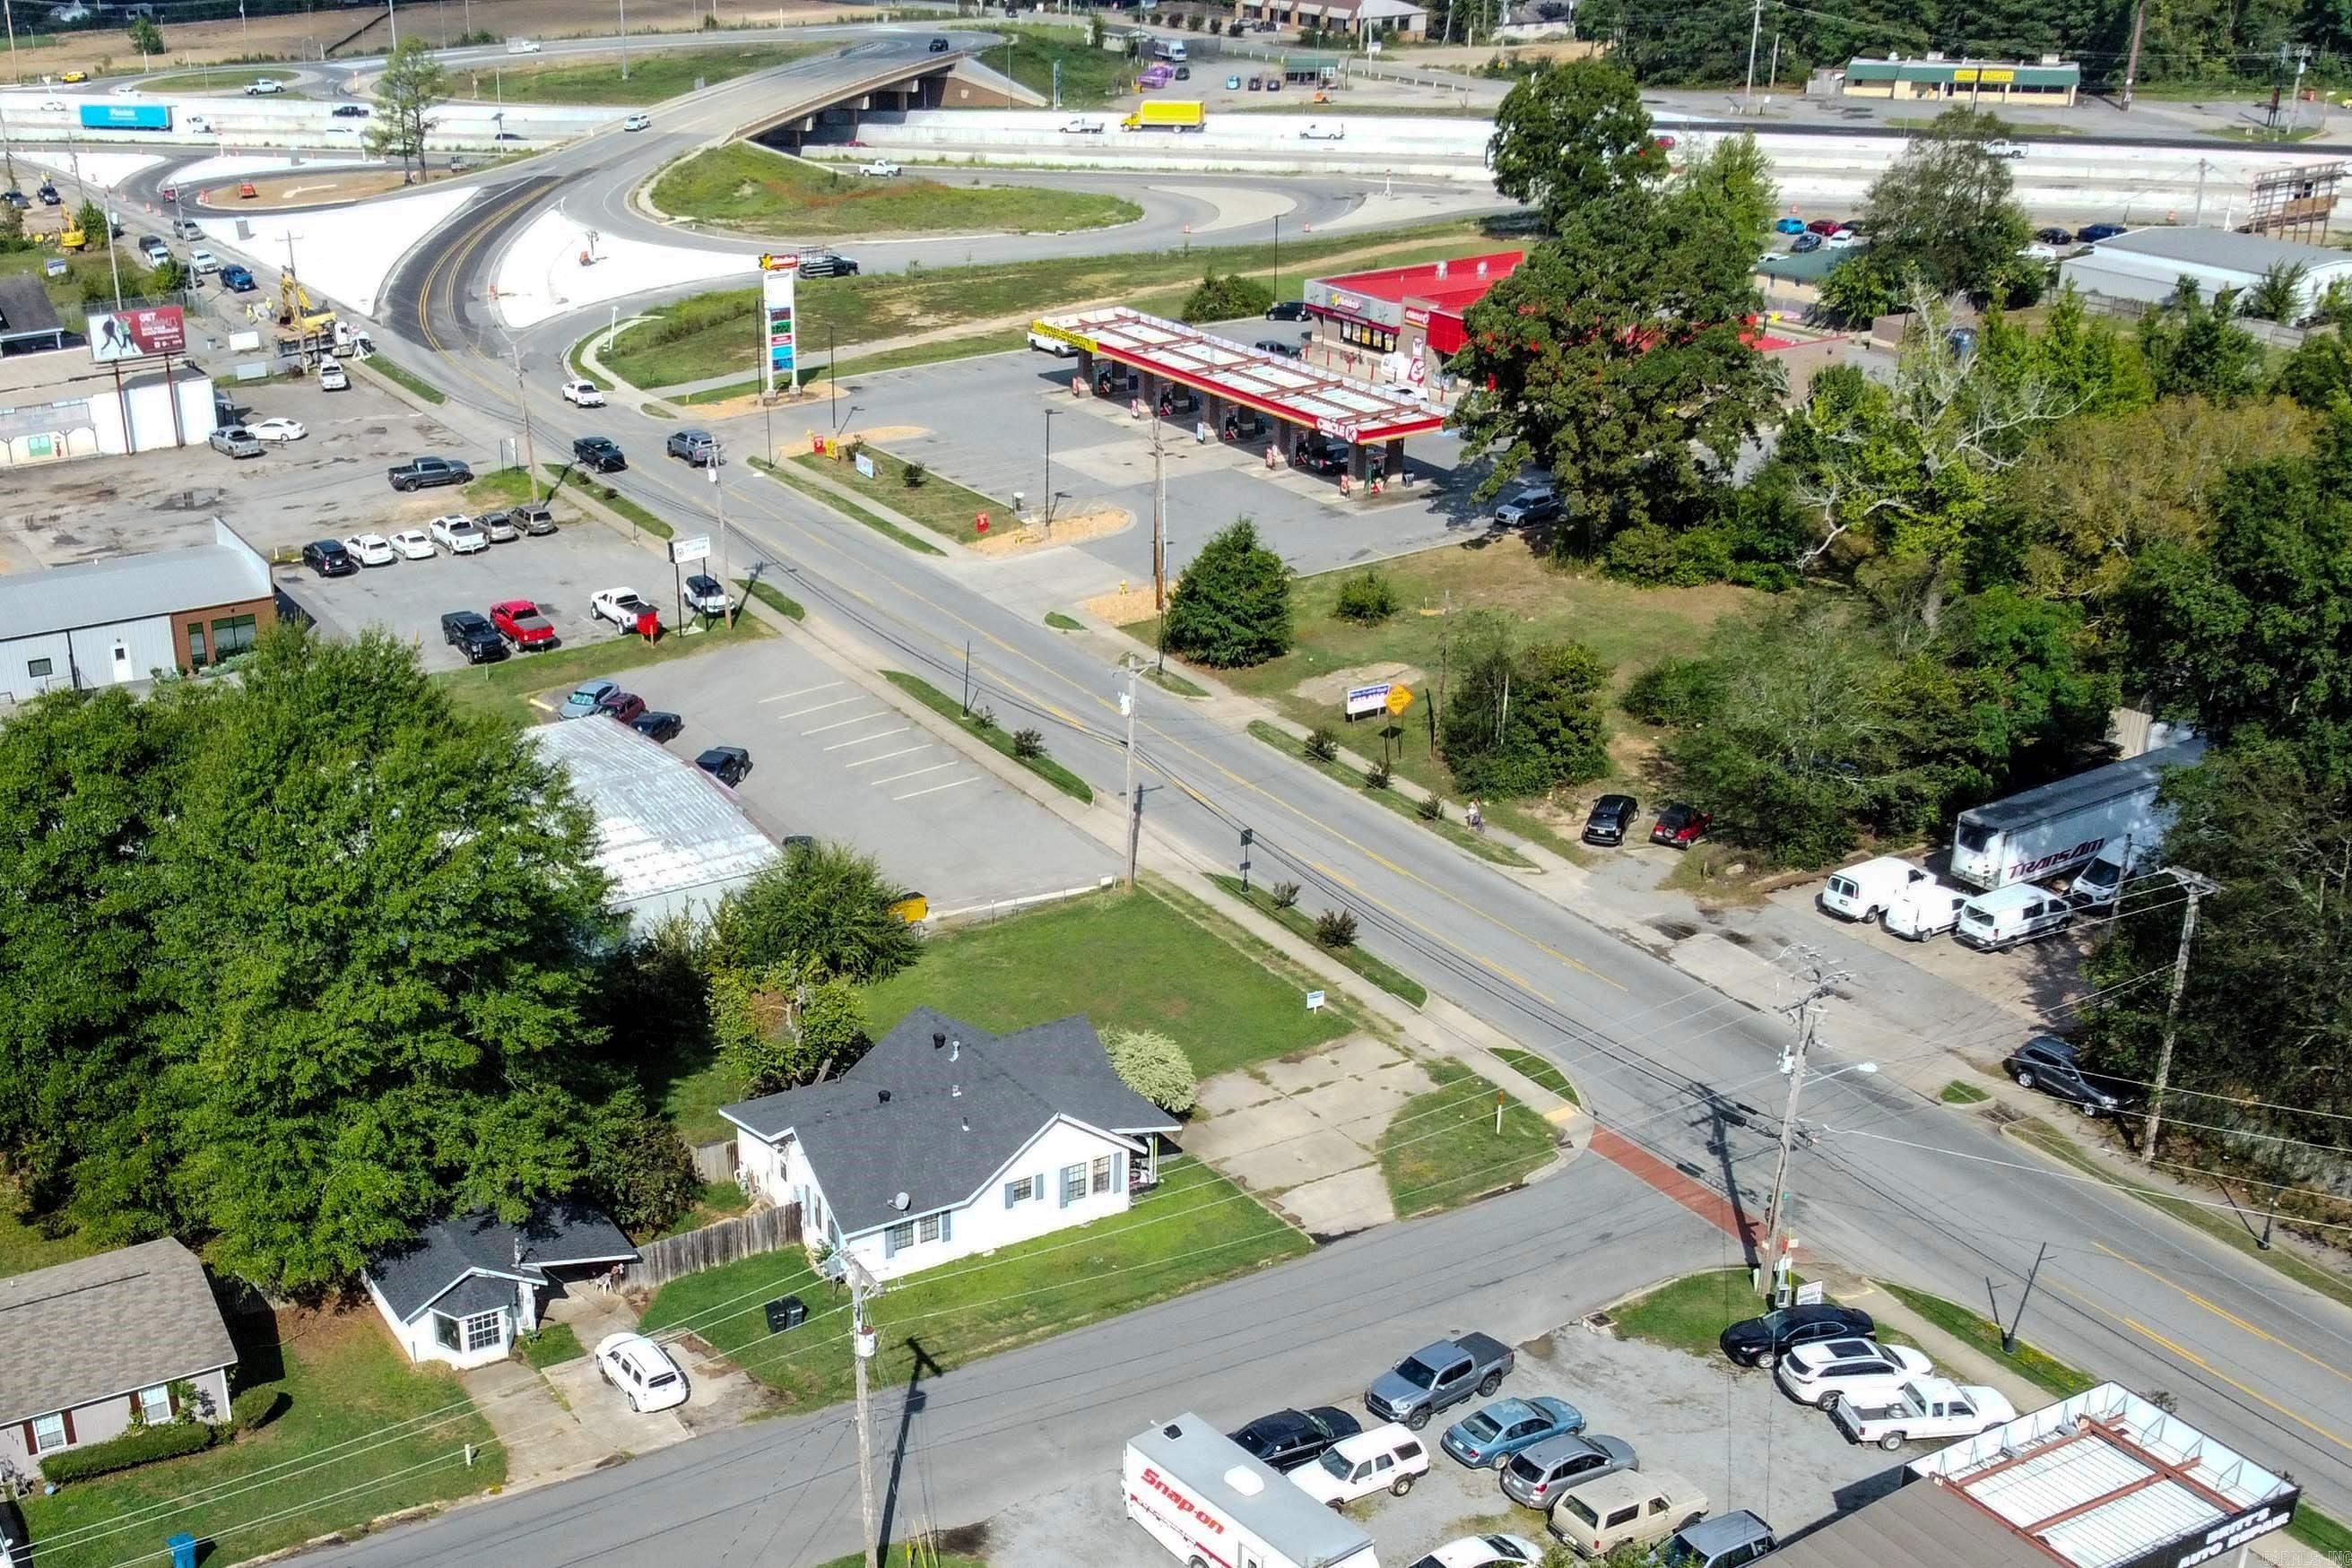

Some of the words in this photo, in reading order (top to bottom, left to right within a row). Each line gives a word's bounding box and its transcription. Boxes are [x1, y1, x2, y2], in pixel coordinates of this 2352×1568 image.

[1316, 418, 1345, 437] CIRCLE
[1141, 1468, 1224, 1534] Snap-on
[2177, 1542, 2224, 1568] AUTO
[2226, 1512, 2291, 1548] REPAIR
